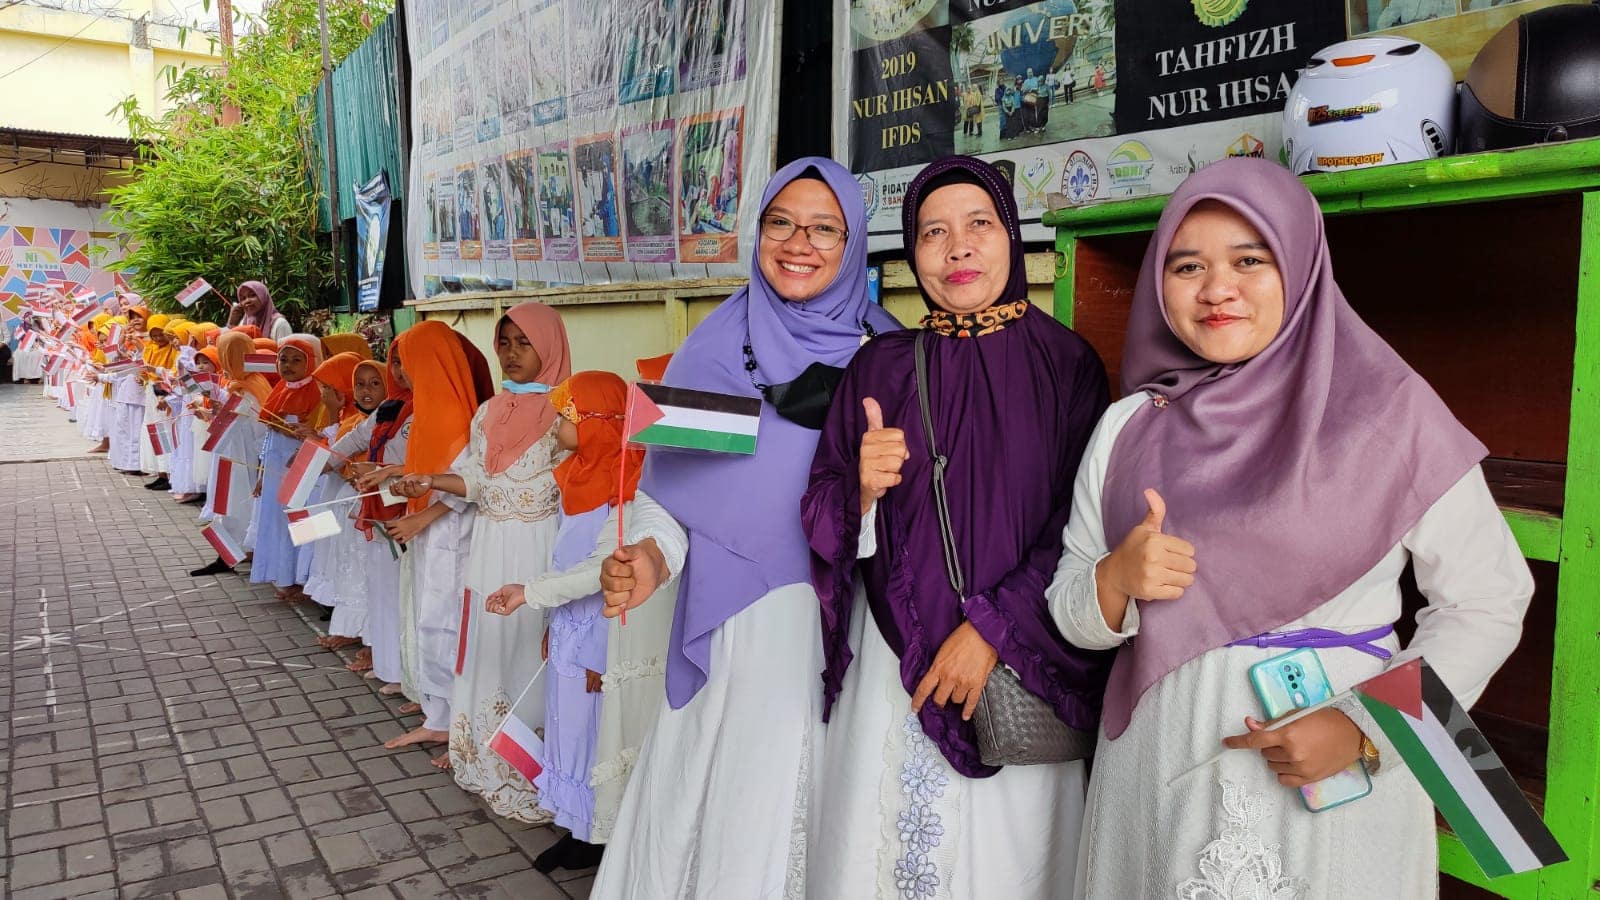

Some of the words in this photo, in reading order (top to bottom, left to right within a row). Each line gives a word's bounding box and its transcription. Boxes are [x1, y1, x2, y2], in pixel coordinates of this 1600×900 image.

[881, 51, 916, 79] 2019
[1155, 22, 1297, 77] TAHFIZH
[852, 95, 888, 120] NUR
[892, 79, 948, 112] IHSAN
[1147, 88, 1211, 120] NUR
[1217, 69, 1302, 110] IHSA
[881, 122, 921, 149] IFDS
[882, 182, 908, 195] PIDAT
